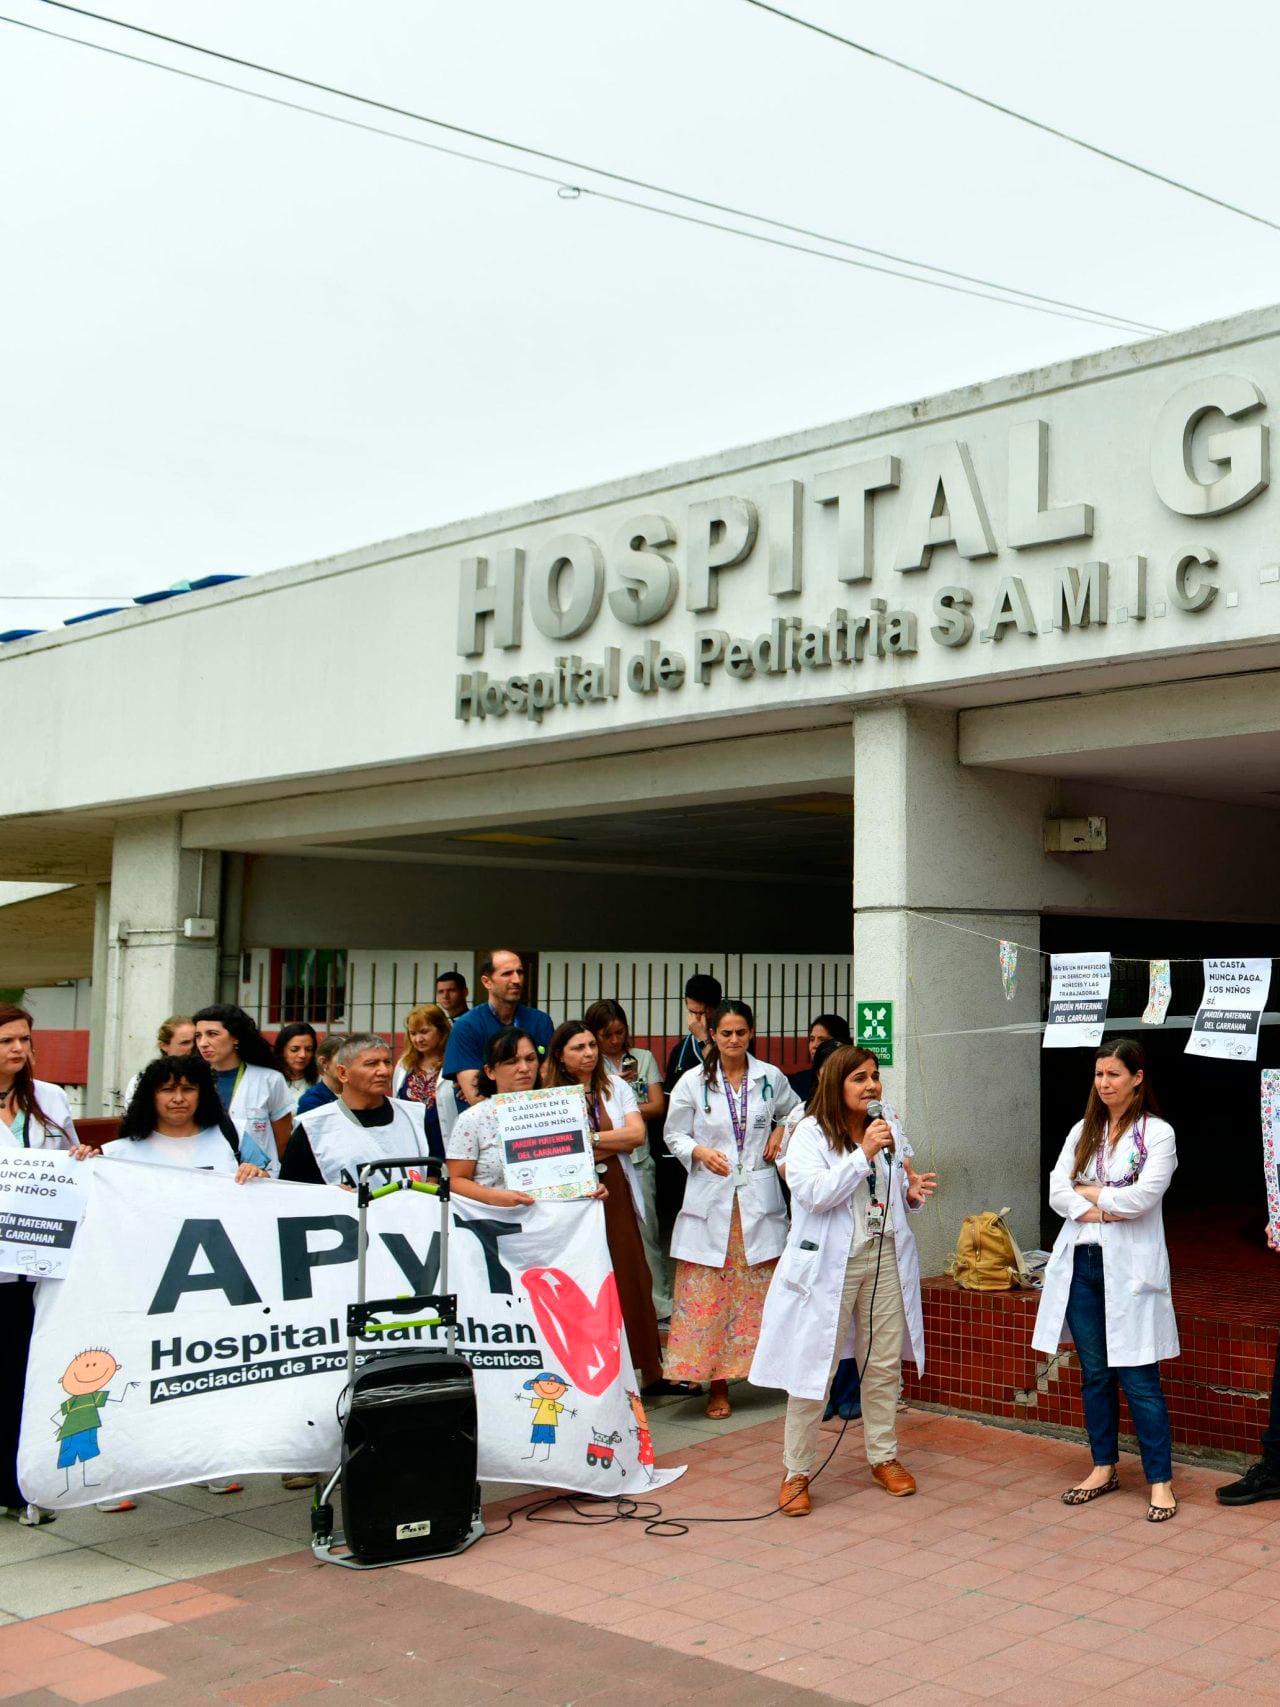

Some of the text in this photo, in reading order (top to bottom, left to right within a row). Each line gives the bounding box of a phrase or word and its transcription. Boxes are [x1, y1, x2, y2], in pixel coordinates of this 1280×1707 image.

[455, 418, 1094, 658] HOSPITAL
[455, 646, 621, 723] Hospital
[627, 640, 686, 694] de
[694, 598, 918, 685] Pediatria
[1238, 974, 1263, 982] PAGA.
[1225, 984, 1251, 994] NIÑOS
[1053, 1001, 1103, 1013] JARDÍN MATERNAL
[1055, 1014, 1098, 1023] DEL GARRAHAN
[1203, 1009, 1252, 1020] JARDÍN MATERNAL
[1204, 1021, 1247, 1031] DEL GARRAHAN
[519, 1103, 547, 1111] AJUSTE
[512, 1110, 557, 1122] GARRAHAN
[534, 1120, 549, 1128] LOS
[13, 1158, 55, 1168] CASTA
[40, 1173, 78, 1186] PAGA.
[15, 1184, 57, 1198] NIÑOS
[17, 1217, 64, 1232] MATERNAL
[5, 1229, 55, 1244] GARRAHAN
[147, 1213, 523, 1316] APyT
[151, 1317, 340, 1371] Hospital
[153, 1364, 274, 1400] Asociación
[279, 1360, 306, 1377] de
[461, 1351, 541, 1367] Técnicos
